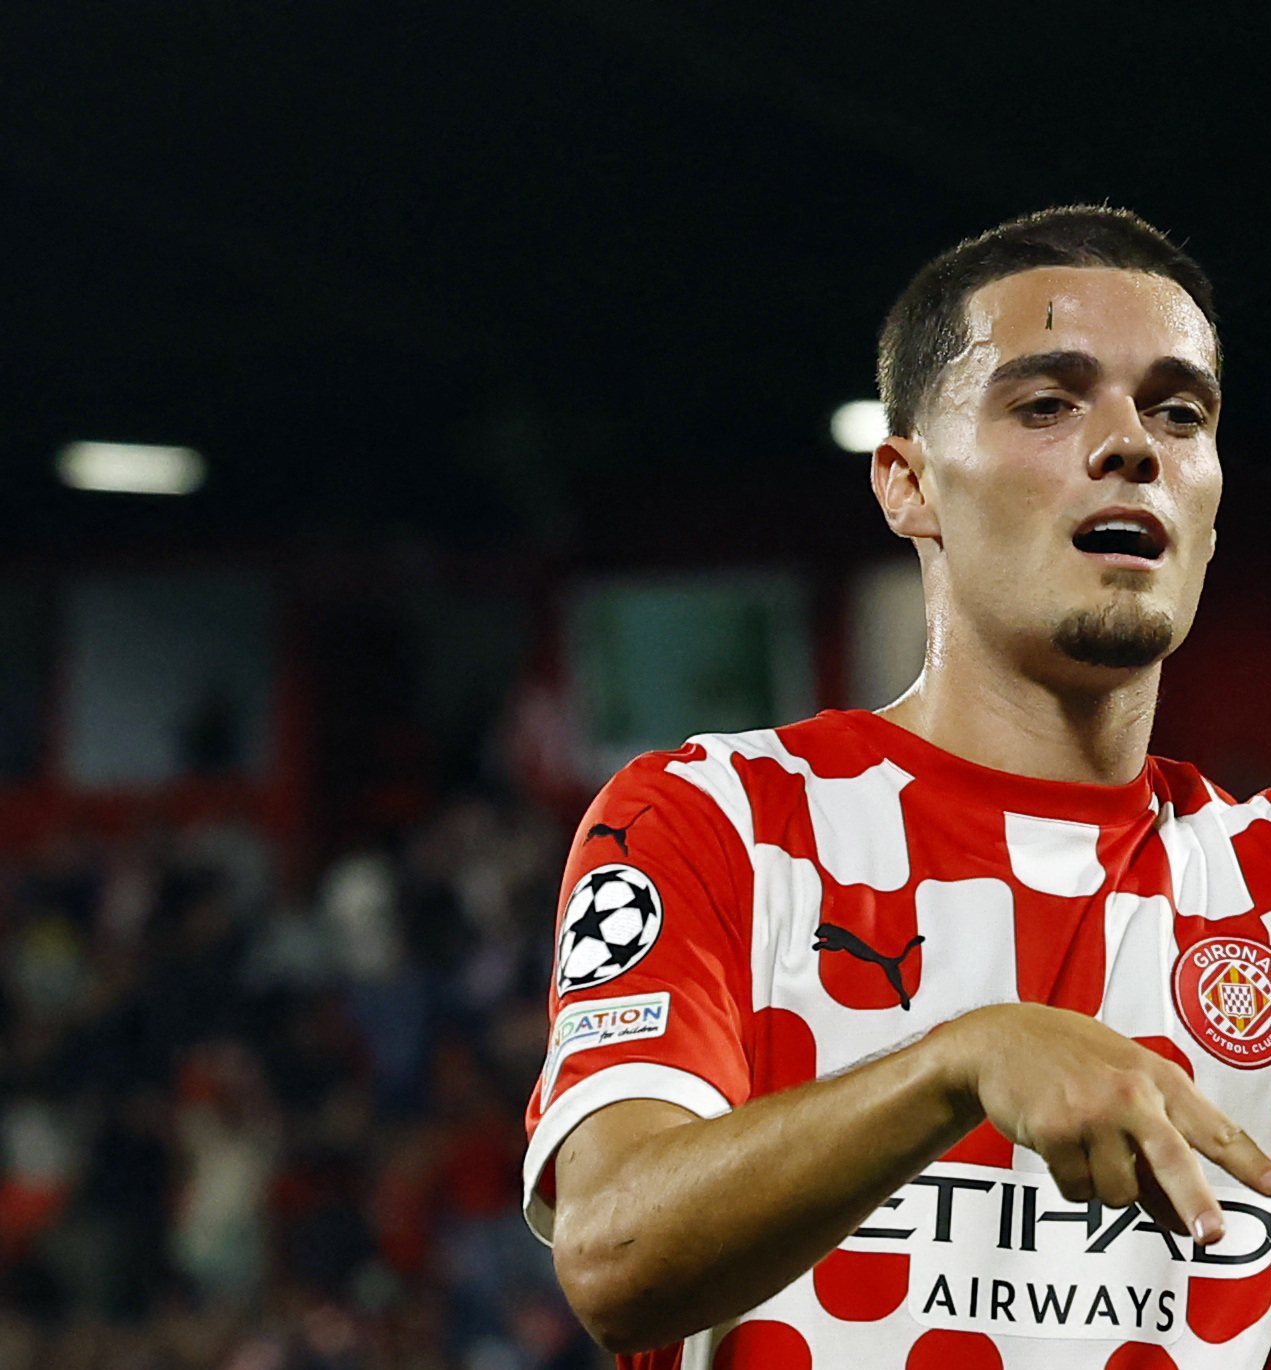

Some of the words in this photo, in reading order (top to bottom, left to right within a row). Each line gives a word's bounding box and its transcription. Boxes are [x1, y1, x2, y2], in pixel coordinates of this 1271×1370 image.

[1193, 943, 1271, 973] GIRONA
[1205, 1027, 1249, 1054] FUTBOL
[922, 1273, 1176, 1332] AIRWAYS
